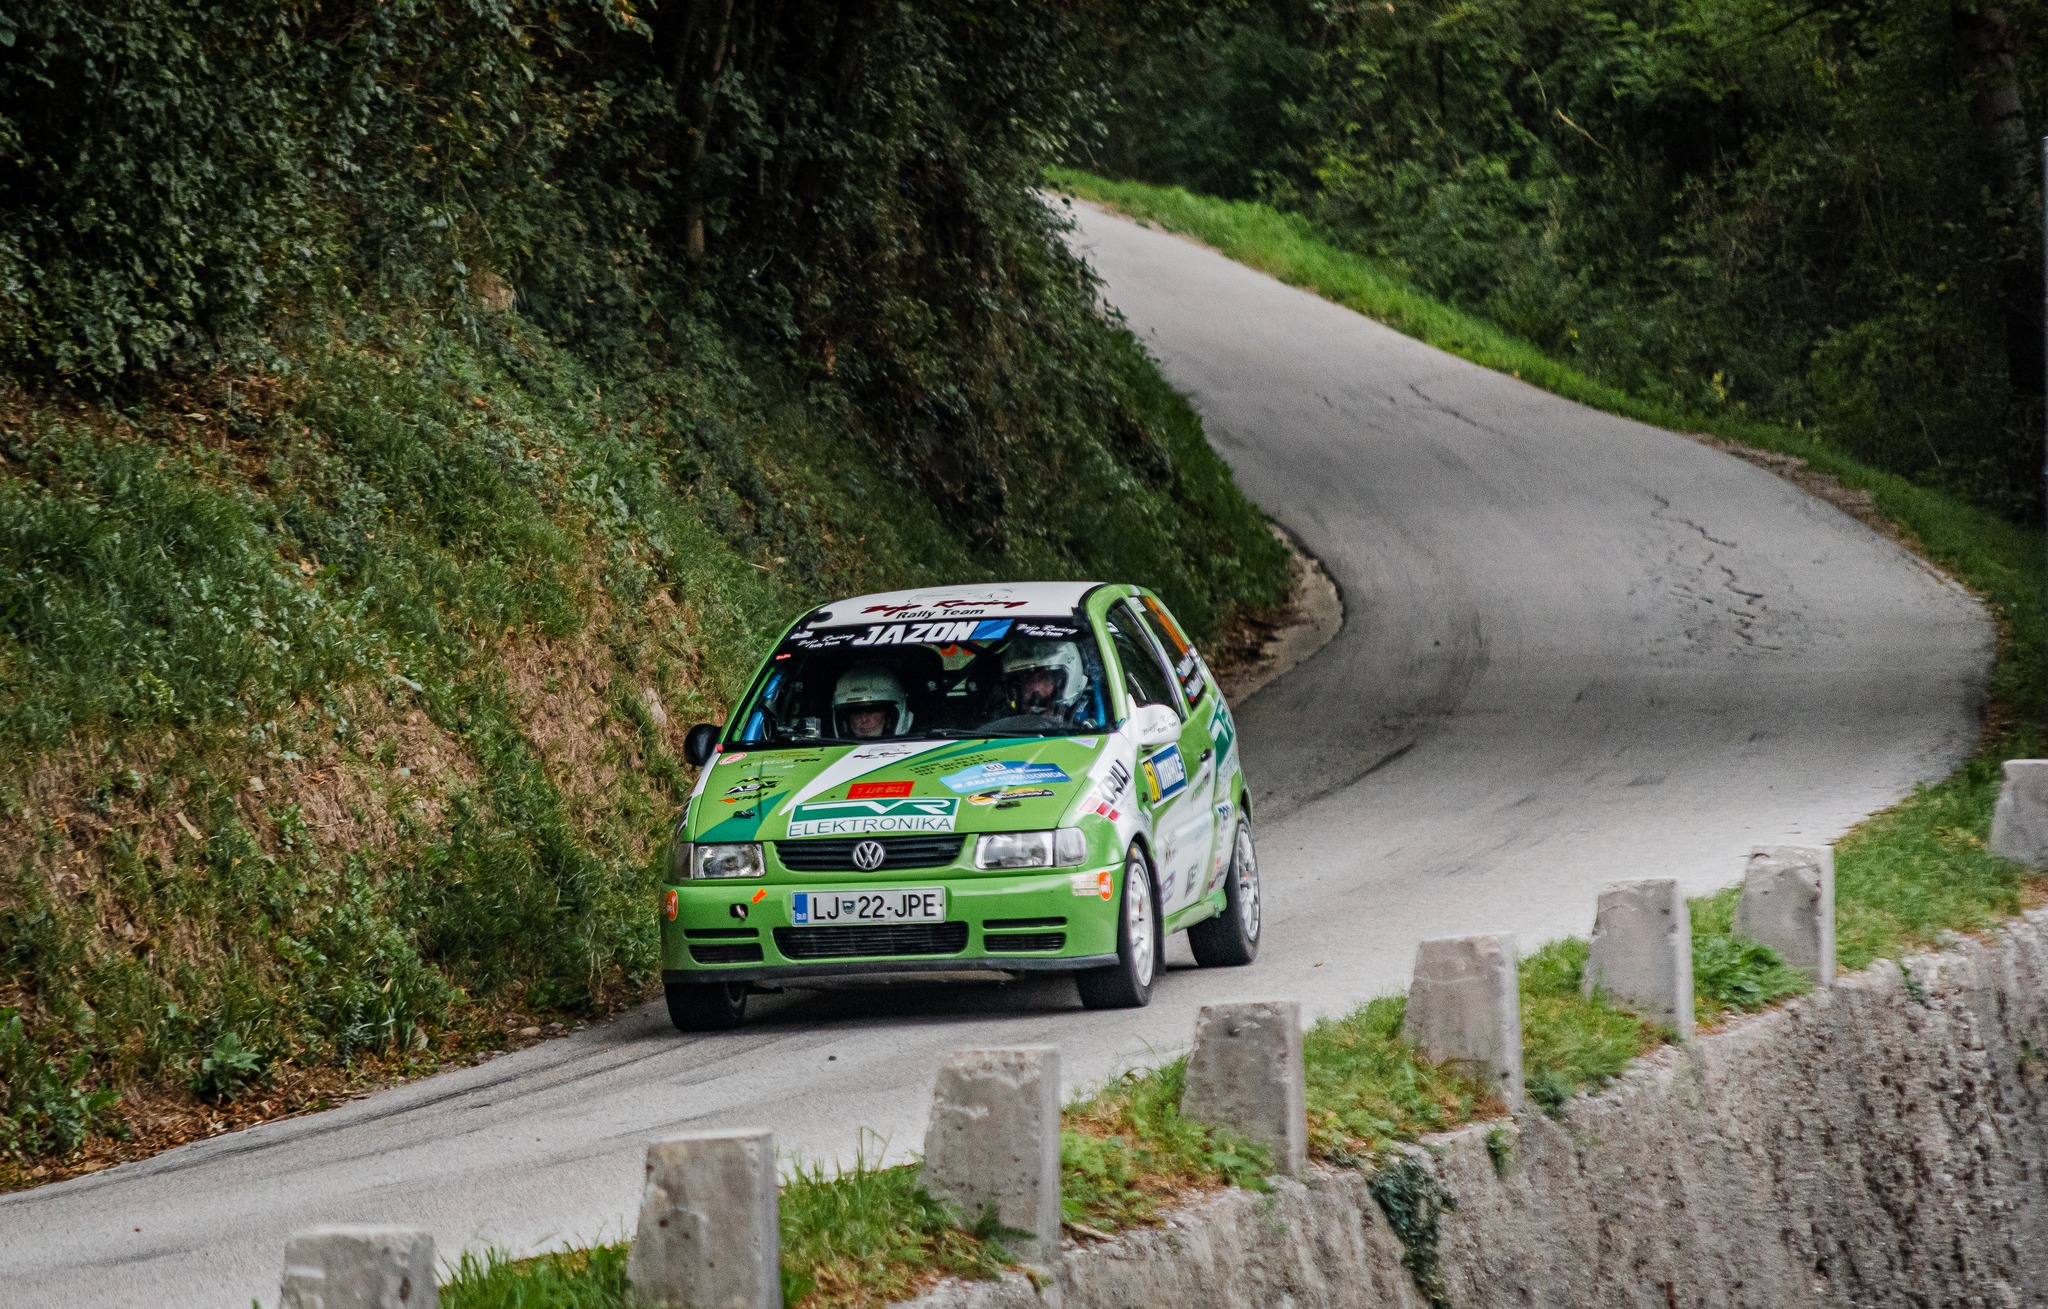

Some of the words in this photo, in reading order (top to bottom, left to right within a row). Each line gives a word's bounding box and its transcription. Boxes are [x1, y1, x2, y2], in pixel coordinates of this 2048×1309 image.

[896, 609, 936, 620] Rally
[943, 608, 984, 617] Team
[853, 620, 980, 646] JAZON
[789, 817, 952, 837] ELEKTRONIKA
[814, 897, 840, 920] LJ
[858, 894, 937, 919] 22-JPE
